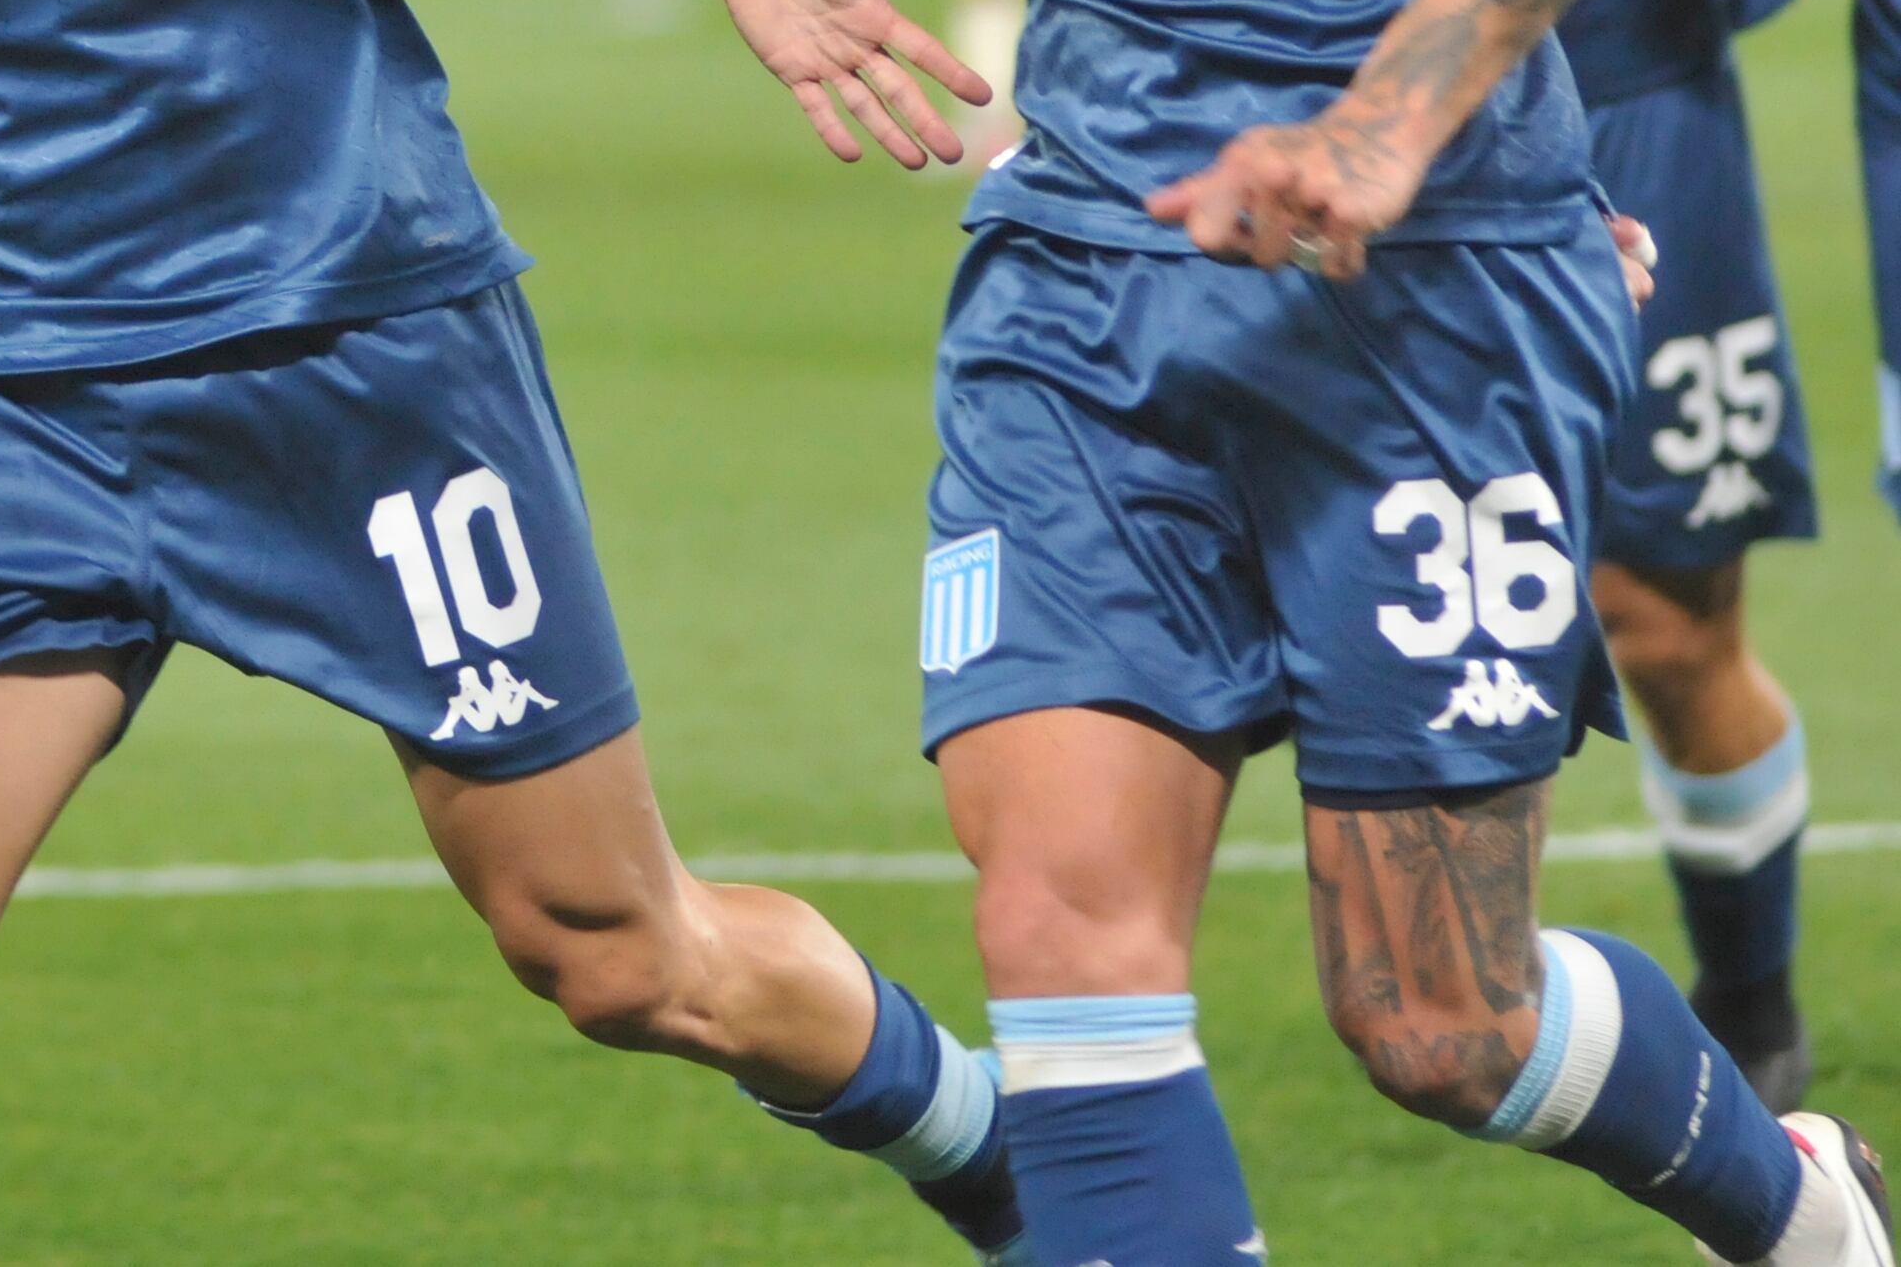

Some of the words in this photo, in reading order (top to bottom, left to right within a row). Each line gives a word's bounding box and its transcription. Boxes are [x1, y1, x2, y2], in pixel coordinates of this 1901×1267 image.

[1646, 314, 1785, 476] 35
[366, 466, 542, 668] 10
[1372, 471, 1577, 659] 36
